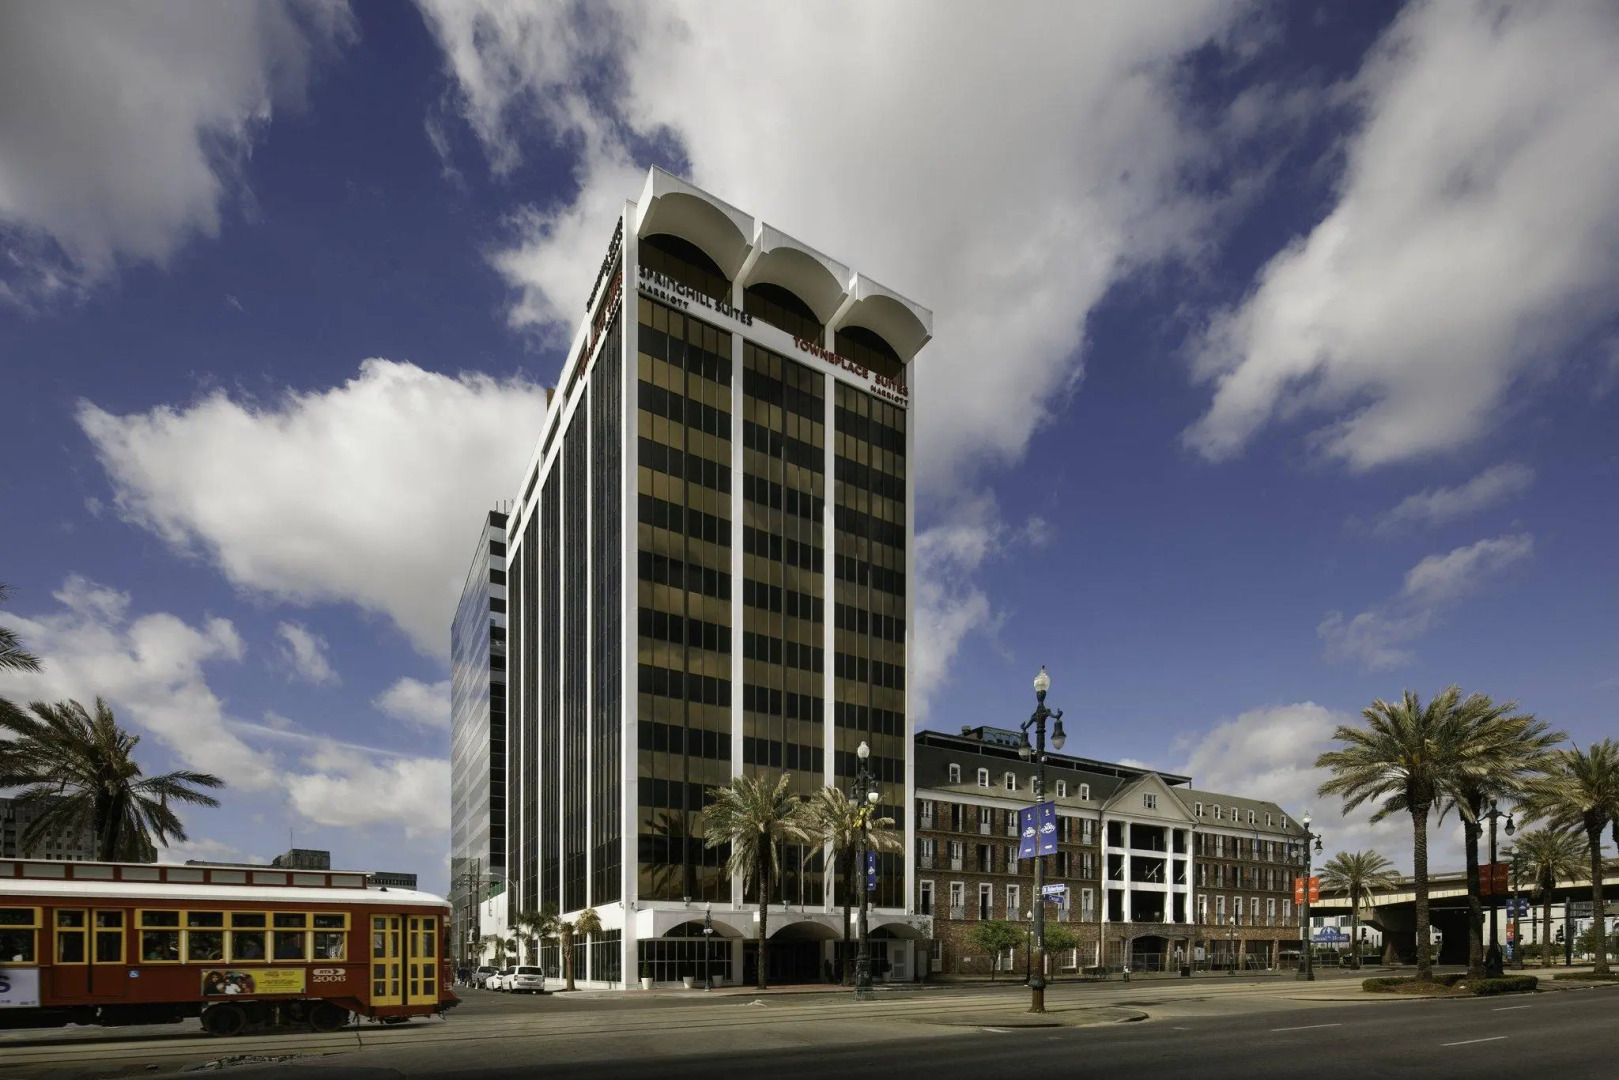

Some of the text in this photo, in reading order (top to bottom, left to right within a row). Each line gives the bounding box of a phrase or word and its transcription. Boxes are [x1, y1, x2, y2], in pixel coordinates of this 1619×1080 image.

[638, 265, 753, 327] SPRINGHILL SUITES
[639, 281, 689, 310] MARRIOTT
[793, 336, 909, 397] TOWNEPLACE SUITES
[870, 385, 909, 407] MARRIOTT
[312, 975, 346, 983] 2006
